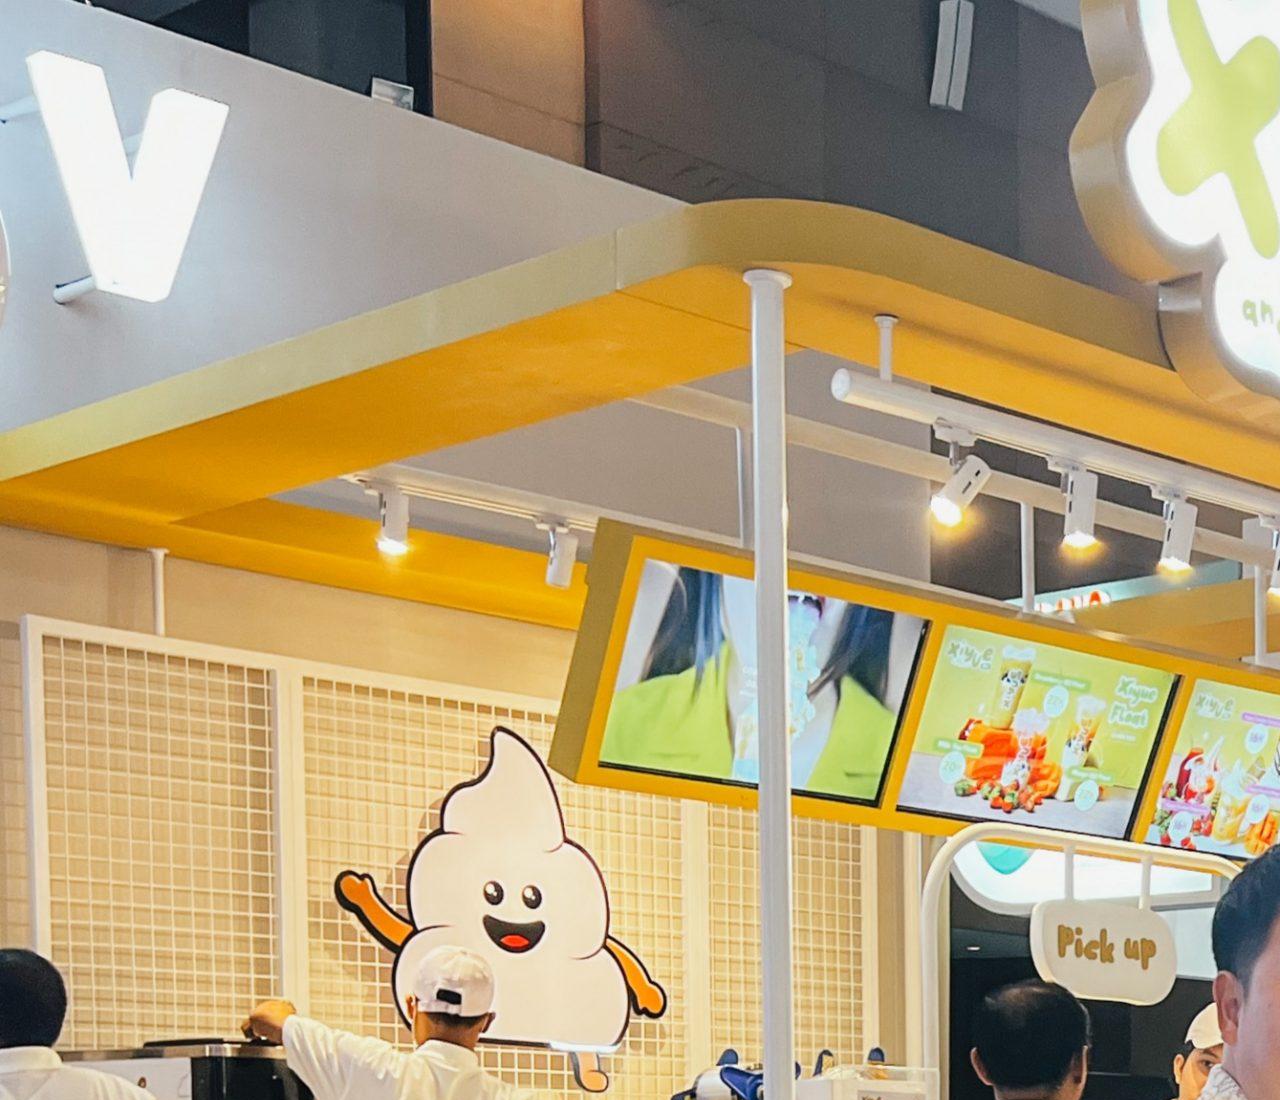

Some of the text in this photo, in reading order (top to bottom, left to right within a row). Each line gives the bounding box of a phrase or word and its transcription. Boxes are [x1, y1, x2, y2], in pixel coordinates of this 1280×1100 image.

[26, 50, 230, 302] V
[1057, 924, 1157, 971] Pick up
